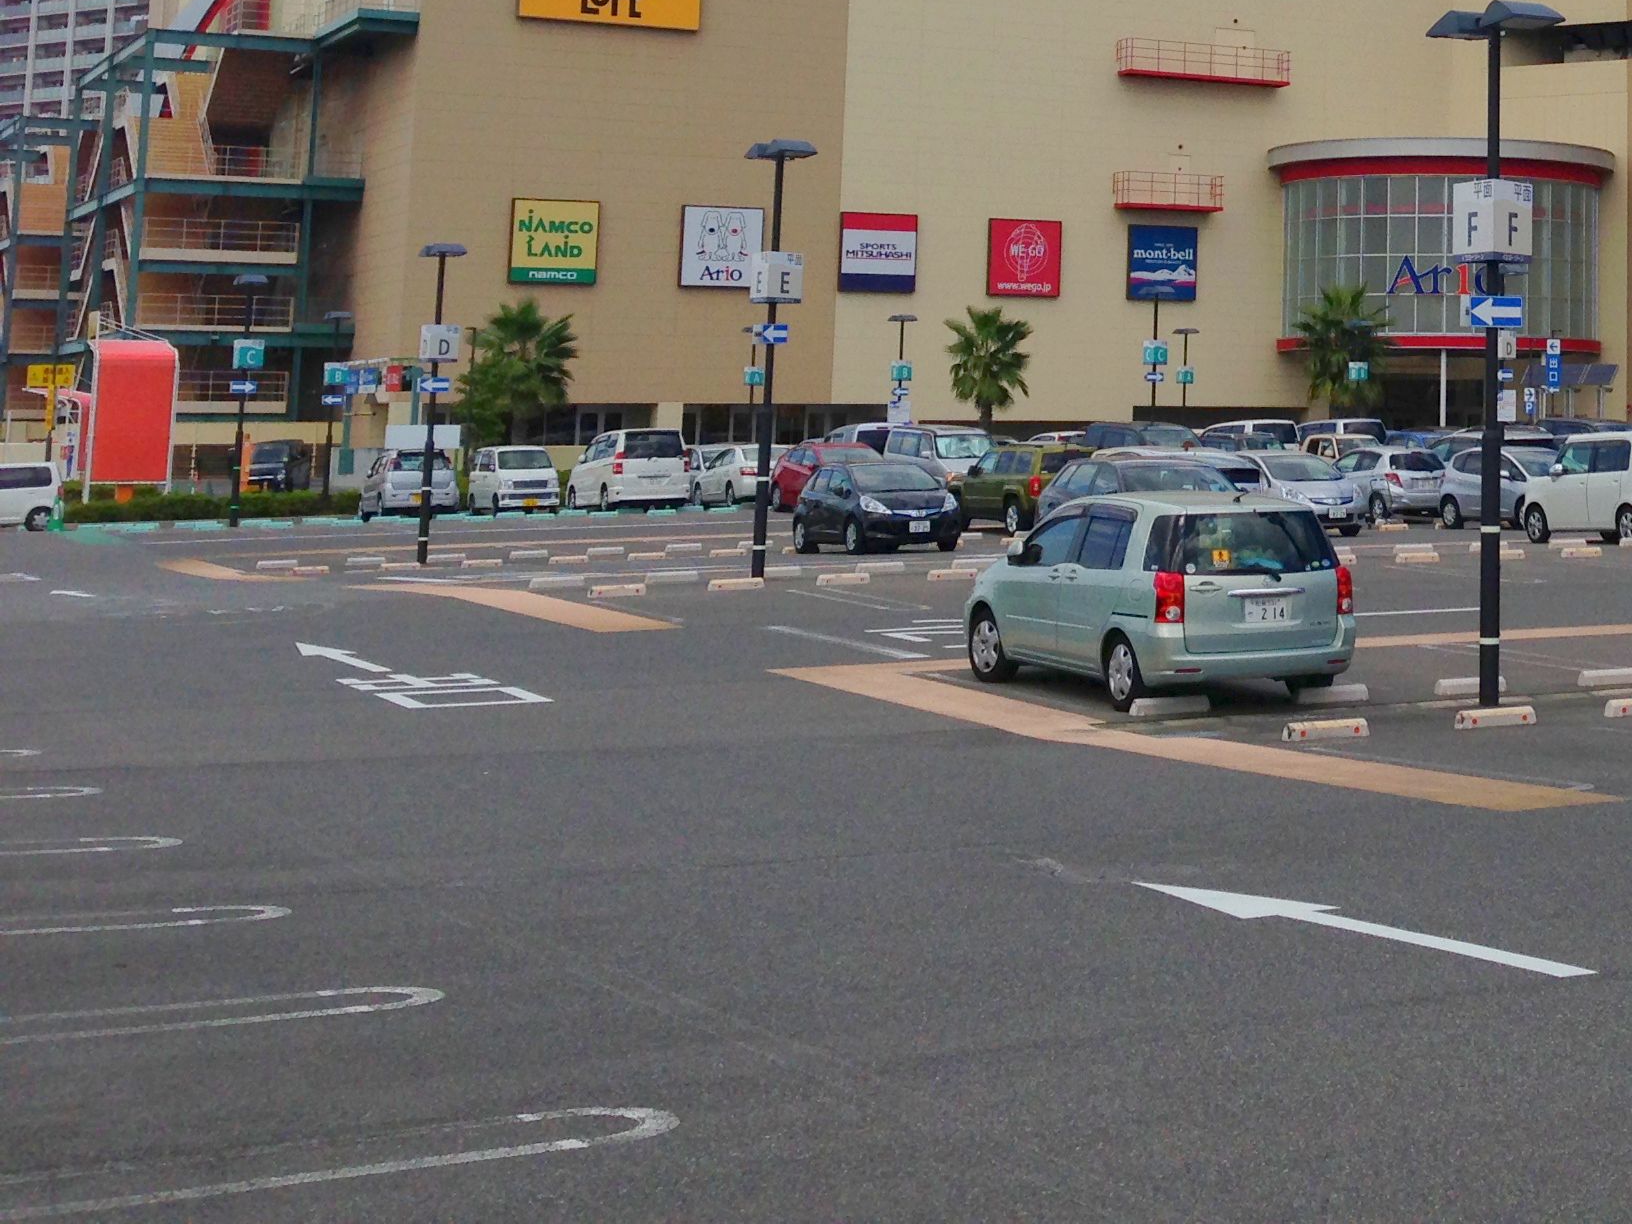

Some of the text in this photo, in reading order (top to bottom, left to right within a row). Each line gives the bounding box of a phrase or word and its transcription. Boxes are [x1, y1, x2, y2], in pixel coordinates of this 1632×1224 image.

[518, 208, 594, 234] NAMCO
[1467, 211, 1479, 248] F
[1508, 211, 1519, 247] F
[526, 235, 583, 258] LAND
[859, 242, 897, 251] SPORTS
[528, 270, 578, 280] namco
[699, 265, 743, 282] Ario
[780, 271, 791, 294] E
[438, 339, 450, 356] D
[1506, 342, 1513, 356] D
[246, 350, 256, 364] C
[1525, 402, 1533, 414] P
